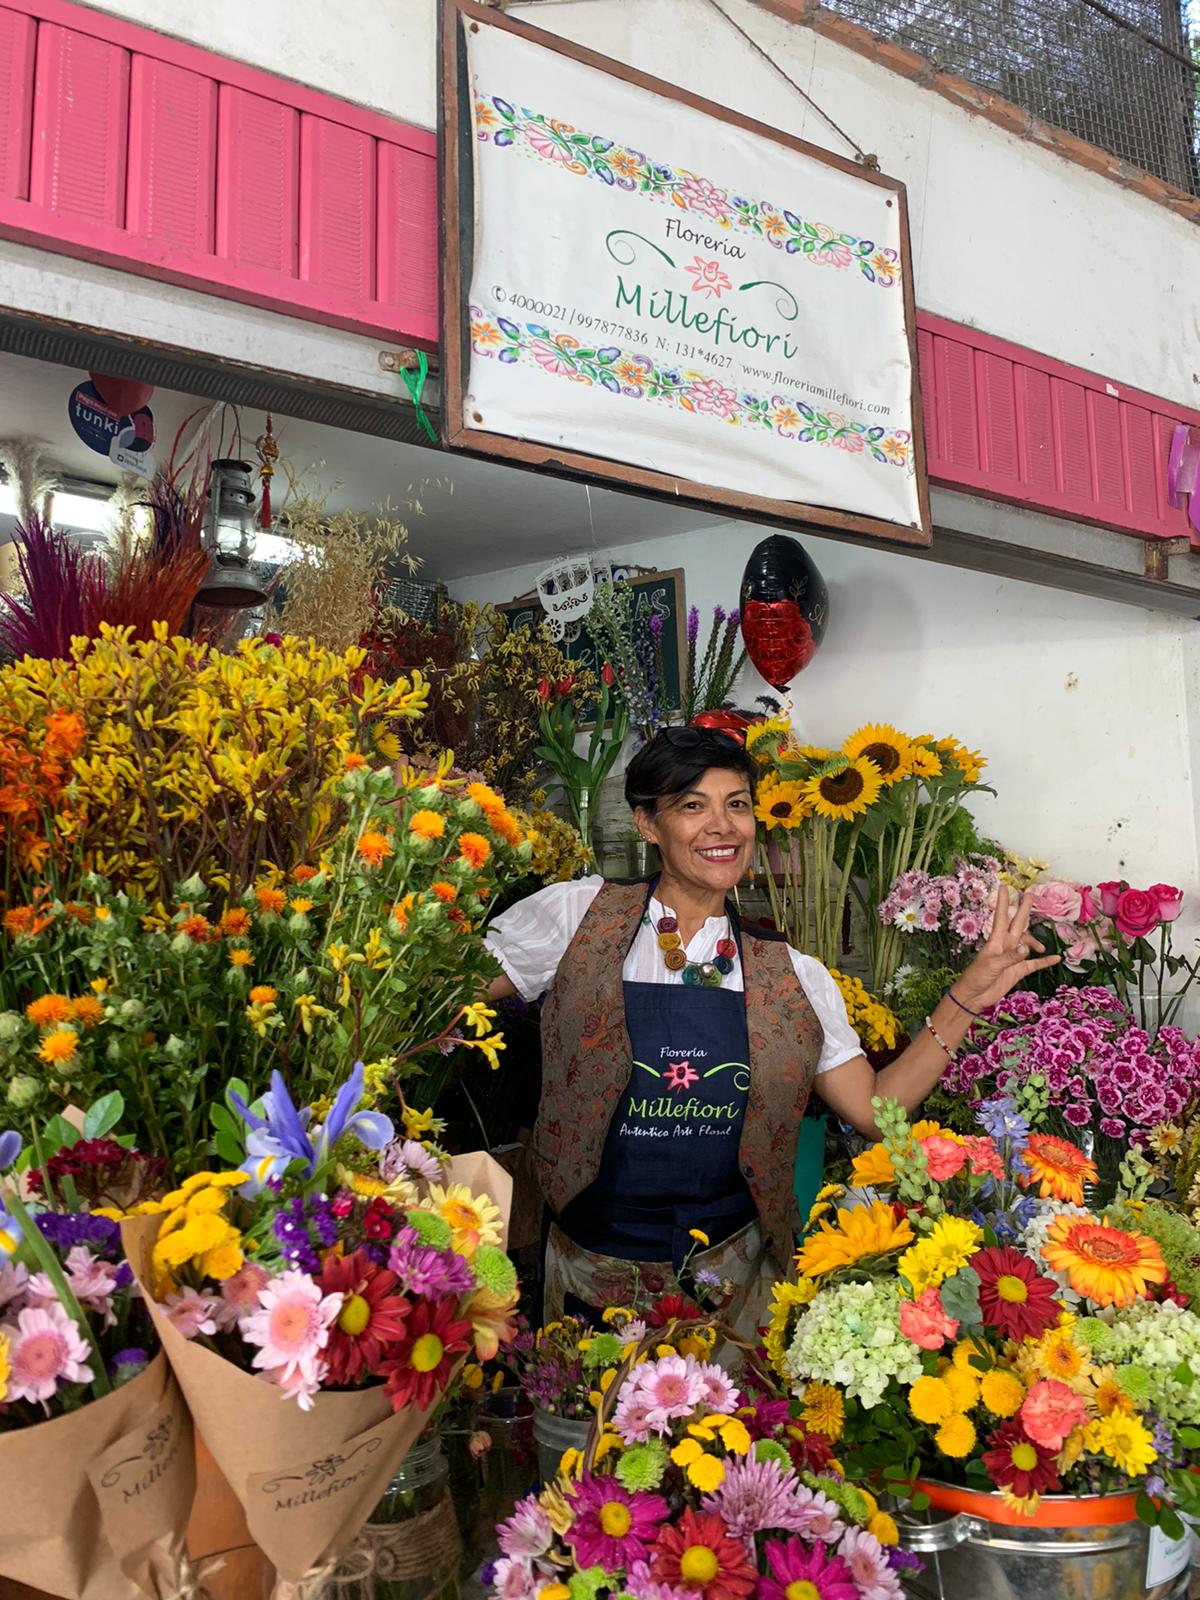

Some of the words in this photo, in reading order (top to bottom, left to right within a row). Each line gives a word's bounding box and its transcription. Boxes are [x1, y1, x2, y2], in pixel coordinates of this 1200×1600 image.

[615, 275, 798, 359] Millefiori
[742, 364, 890, 416] www.floreriamillefiori.com
[75, 403, 119, 435] tunki
[628, 1097, 740, 1121] Millefiori
[672, 1124, 694, 1138] Arte
[698, 1124, 732, 1137] Floral
